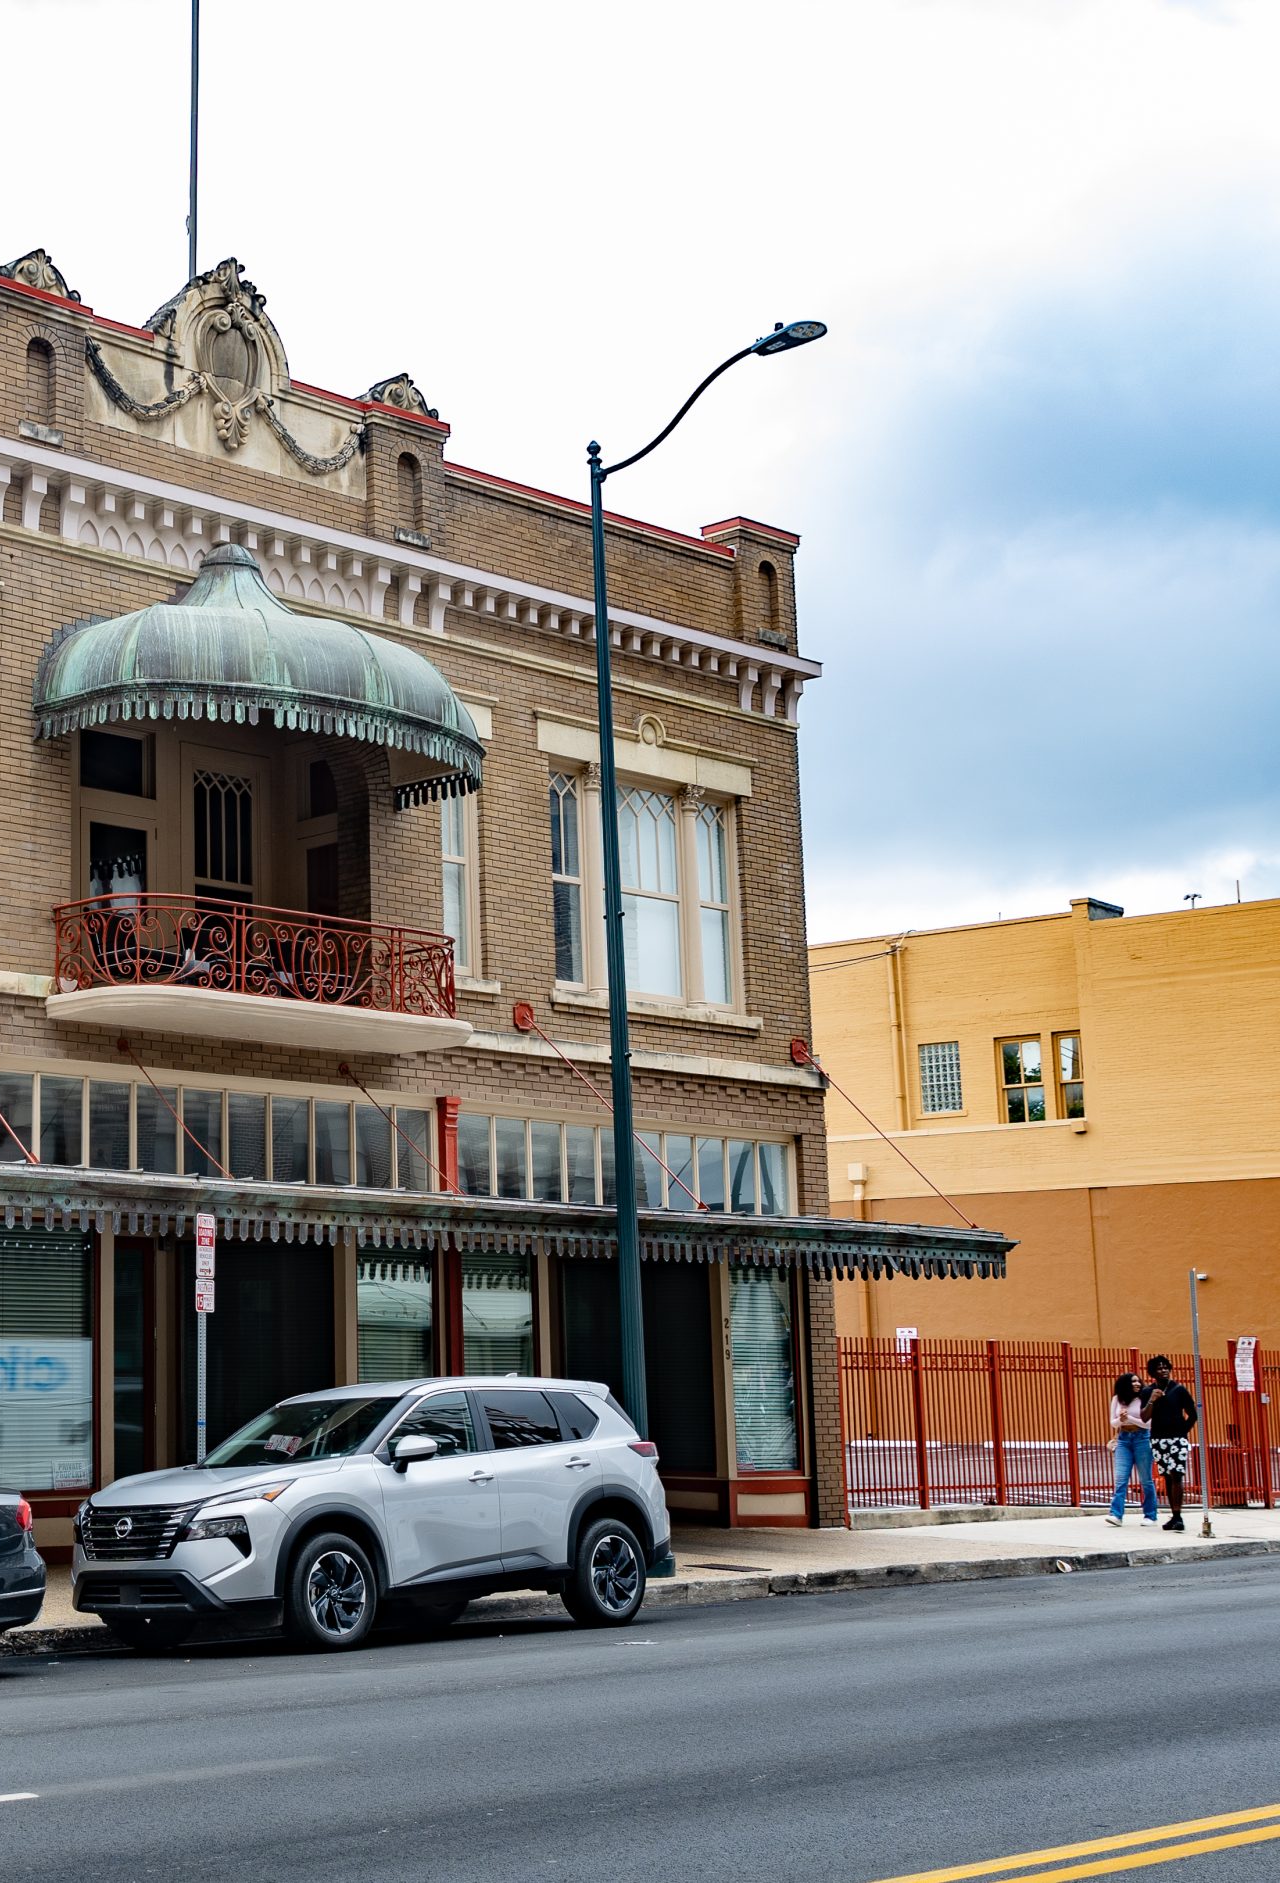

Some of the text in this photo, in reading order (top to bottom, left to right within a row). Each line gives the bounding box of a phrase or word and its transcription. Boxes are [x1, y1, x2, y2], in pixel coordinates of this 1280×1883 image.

[198, 1228, 213, 1238] LOADING
[201, 1238, 210, 1246] ZONE
[197, 1295, 204, 1309] 15
